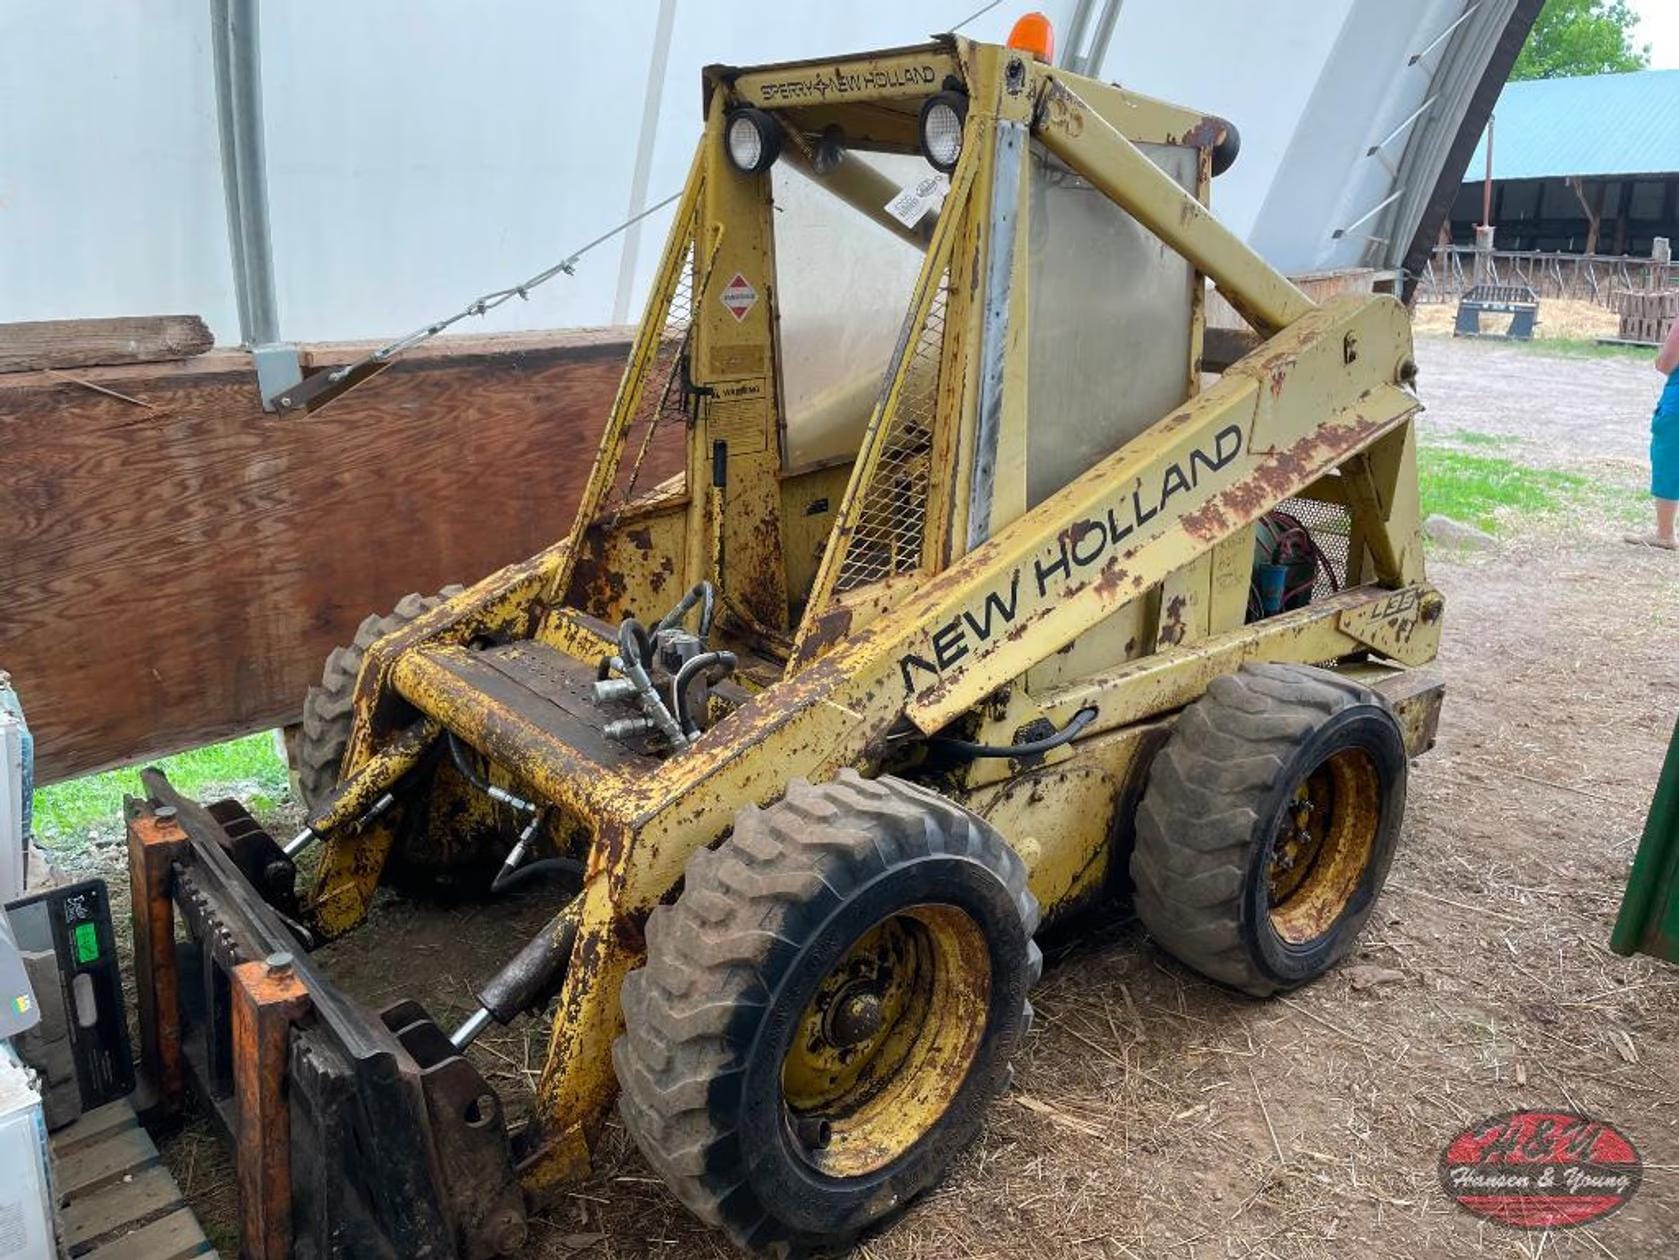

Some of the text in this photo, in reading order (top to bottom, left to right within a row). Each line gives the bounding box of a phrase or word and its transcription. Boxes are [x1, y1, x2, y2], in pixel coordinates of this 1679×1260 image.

[760, 66, 936, 101] SPERRY NEW HOLLAND
[899, 424, 1243, 695] NEW HOLLAND
